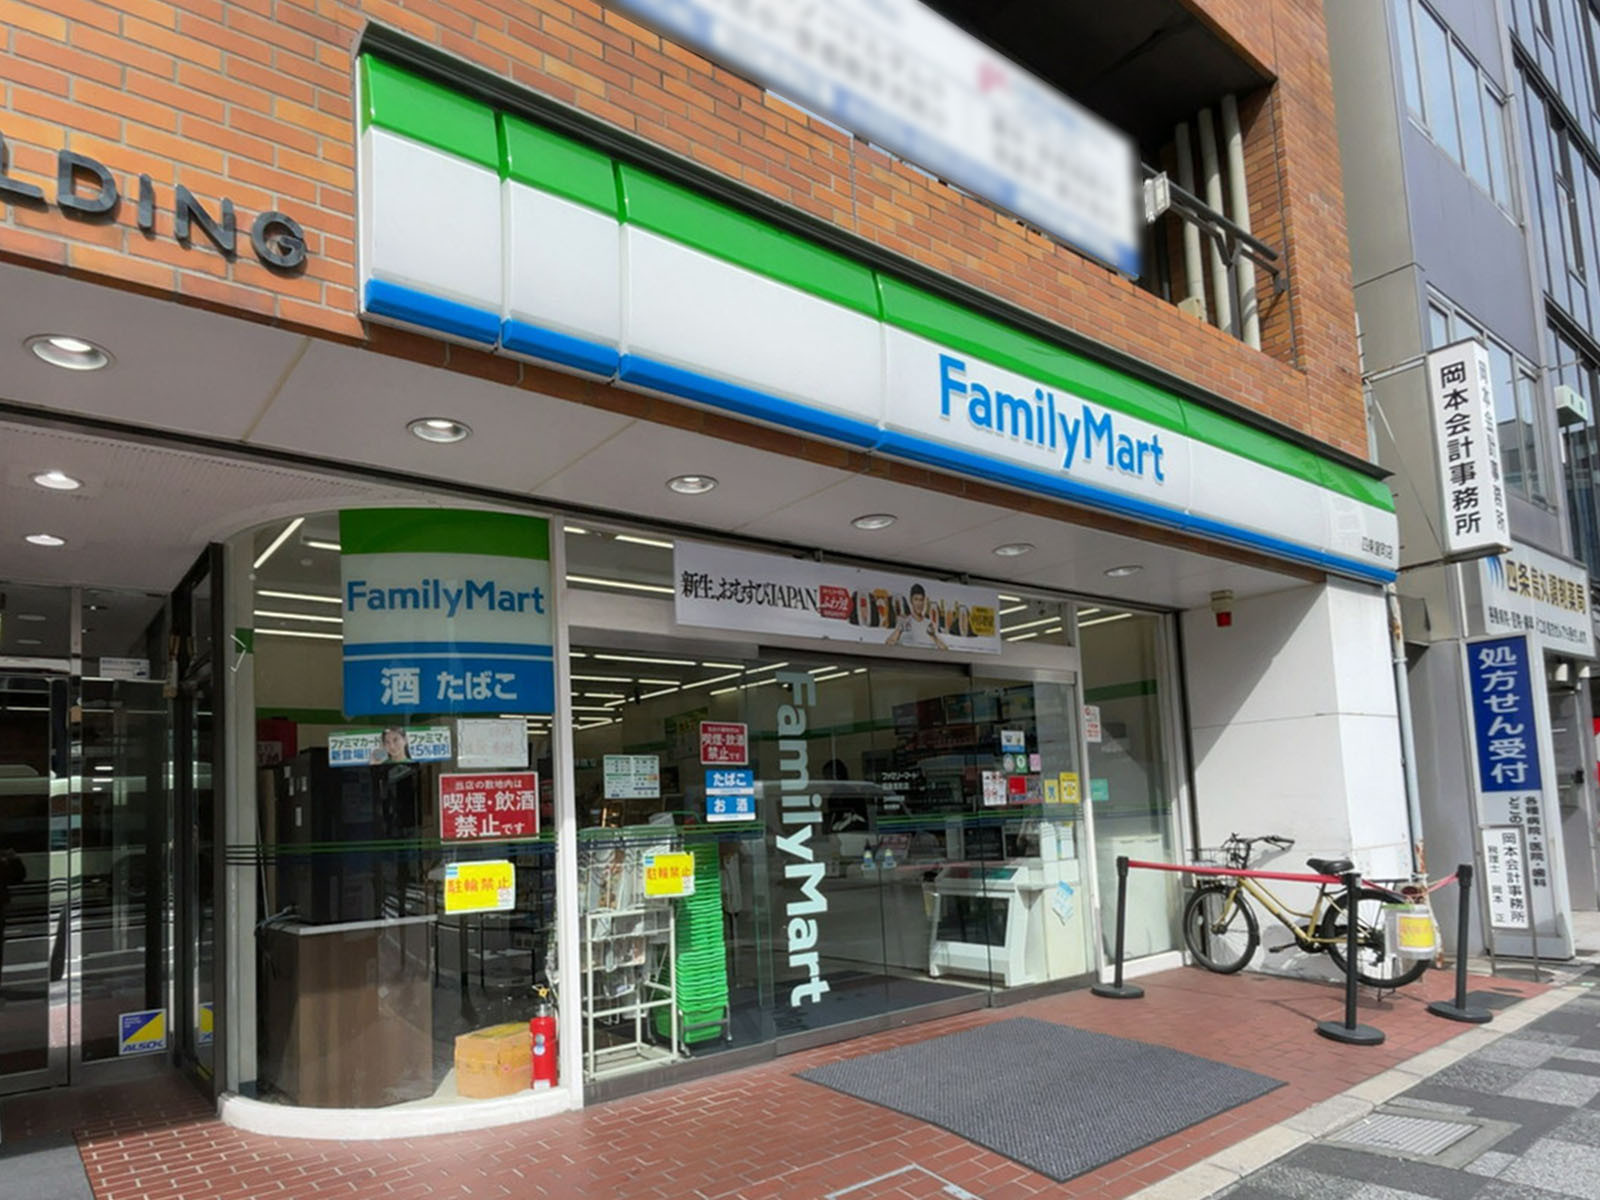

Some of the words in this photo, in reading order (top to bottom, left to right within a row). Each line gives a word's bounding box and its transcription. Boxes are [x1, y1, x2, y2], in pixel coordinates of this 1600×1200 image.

[938, 353, 1164, 482] FamilyMart
[1440, 360, 1481, 536] 岡本会計事務所
[347, 579, 544, 618] FamilyMart
[381, 667, 420, 706] 酒
[437, 671, 517, 700] たばこ
[1478, 645, 1528, 784] 処方せん受付
[713, 772, 746, 786] たばこ
[443, 791, 536, 814] 喫煙・飲酒
[455, 814, 525, 838] 禁止です
[776, 671, 831, 1008] FamilyMart
[447, 876, 511, 893] 駐輪禁止
[1502, 832, 1525, 923] 岡本会計事務所
